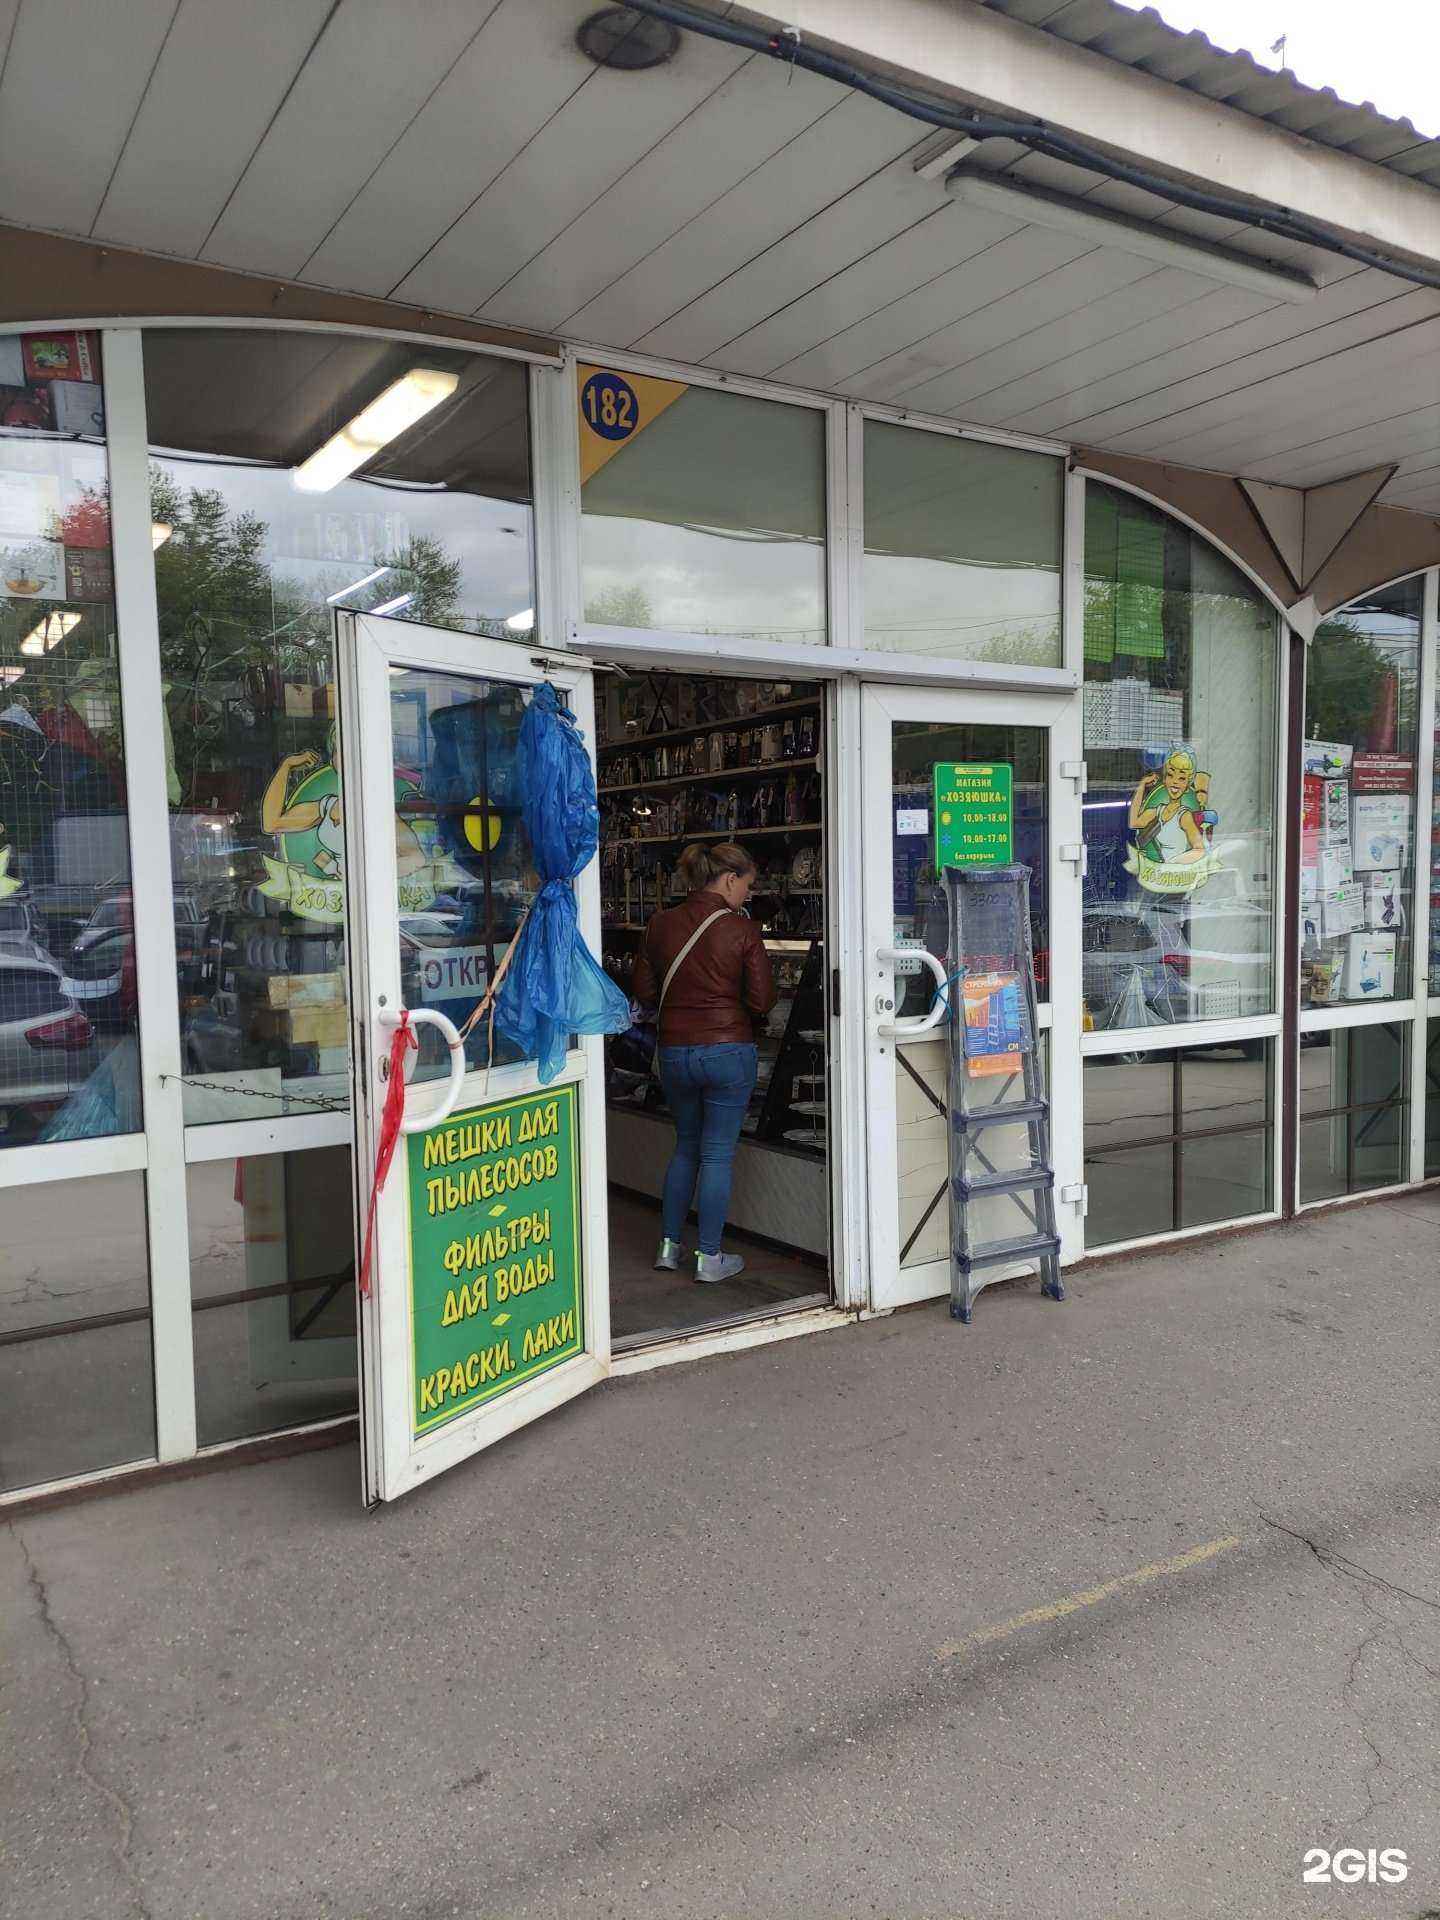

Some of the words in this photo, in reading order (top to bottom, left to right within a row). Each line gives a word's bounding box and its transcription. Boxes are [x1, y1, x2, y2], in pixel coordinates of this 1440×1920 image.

[587, 386, 633, 428] 182
[955, 778, 993, 788] МАГАЗИН
[424, 955, 511, 990] ОТКР
[423, 1116, 512, 1169] МЕШКИ
[517, 1102, 560, 1144] ДЛЯ
[426, 1145, 558, 1217] ПЫЛЕСОСОВ
[443, 1208, 551, 1276] ФИЛЬТРЫ
[441, 1275, 488, 1327] ДЛЯ
[494, 1249, 555, 1303] ВОДЫ
[522, 1309, 574, 1362] ЛАКИ
